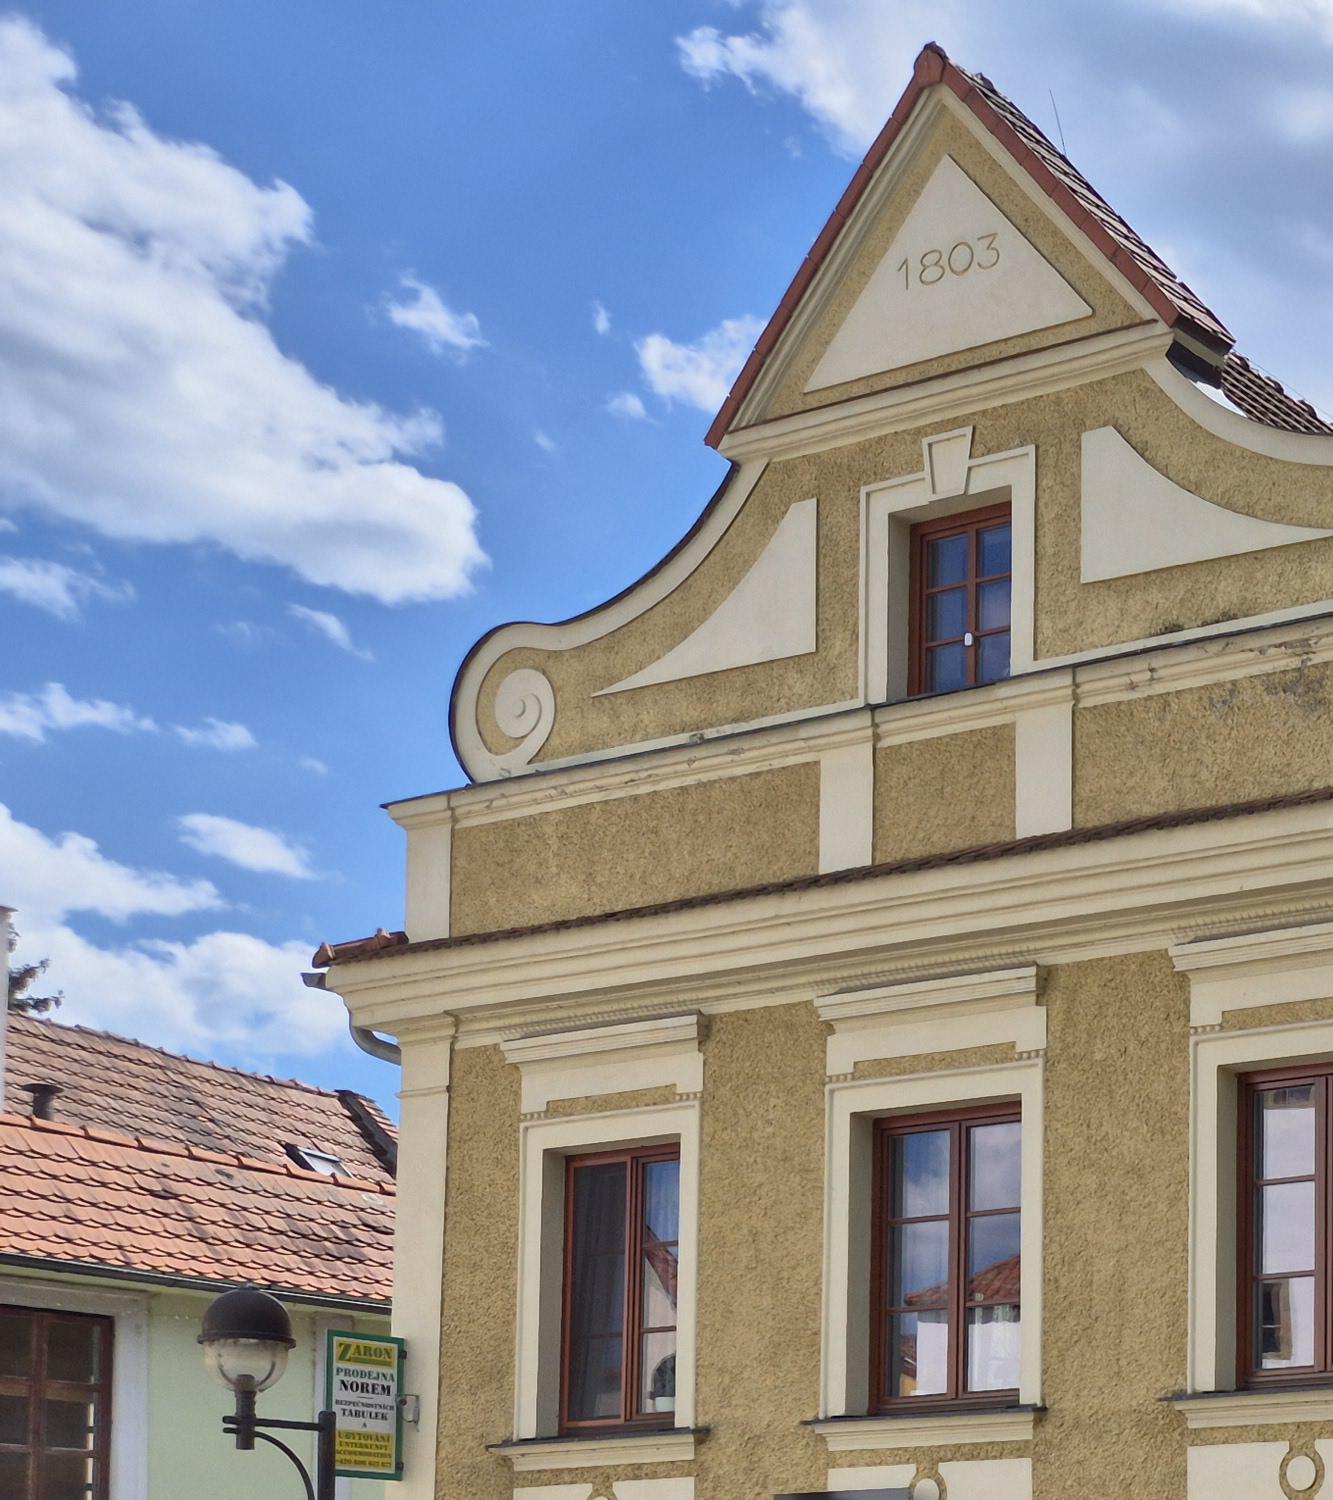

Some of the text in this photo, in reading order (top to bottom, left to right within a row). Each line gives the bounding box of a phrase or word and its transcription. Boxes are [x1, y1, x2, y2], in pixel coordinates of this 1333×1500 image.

[898, 232, 1000, 291] 1803
[337, 1342, 393, 1362] ZARON
[335, 1367, 395, 1383] PRODEJNA
[339, 1379, 392, 1396] NOREM
[341, 1407, 389, 1421] TABULEK
